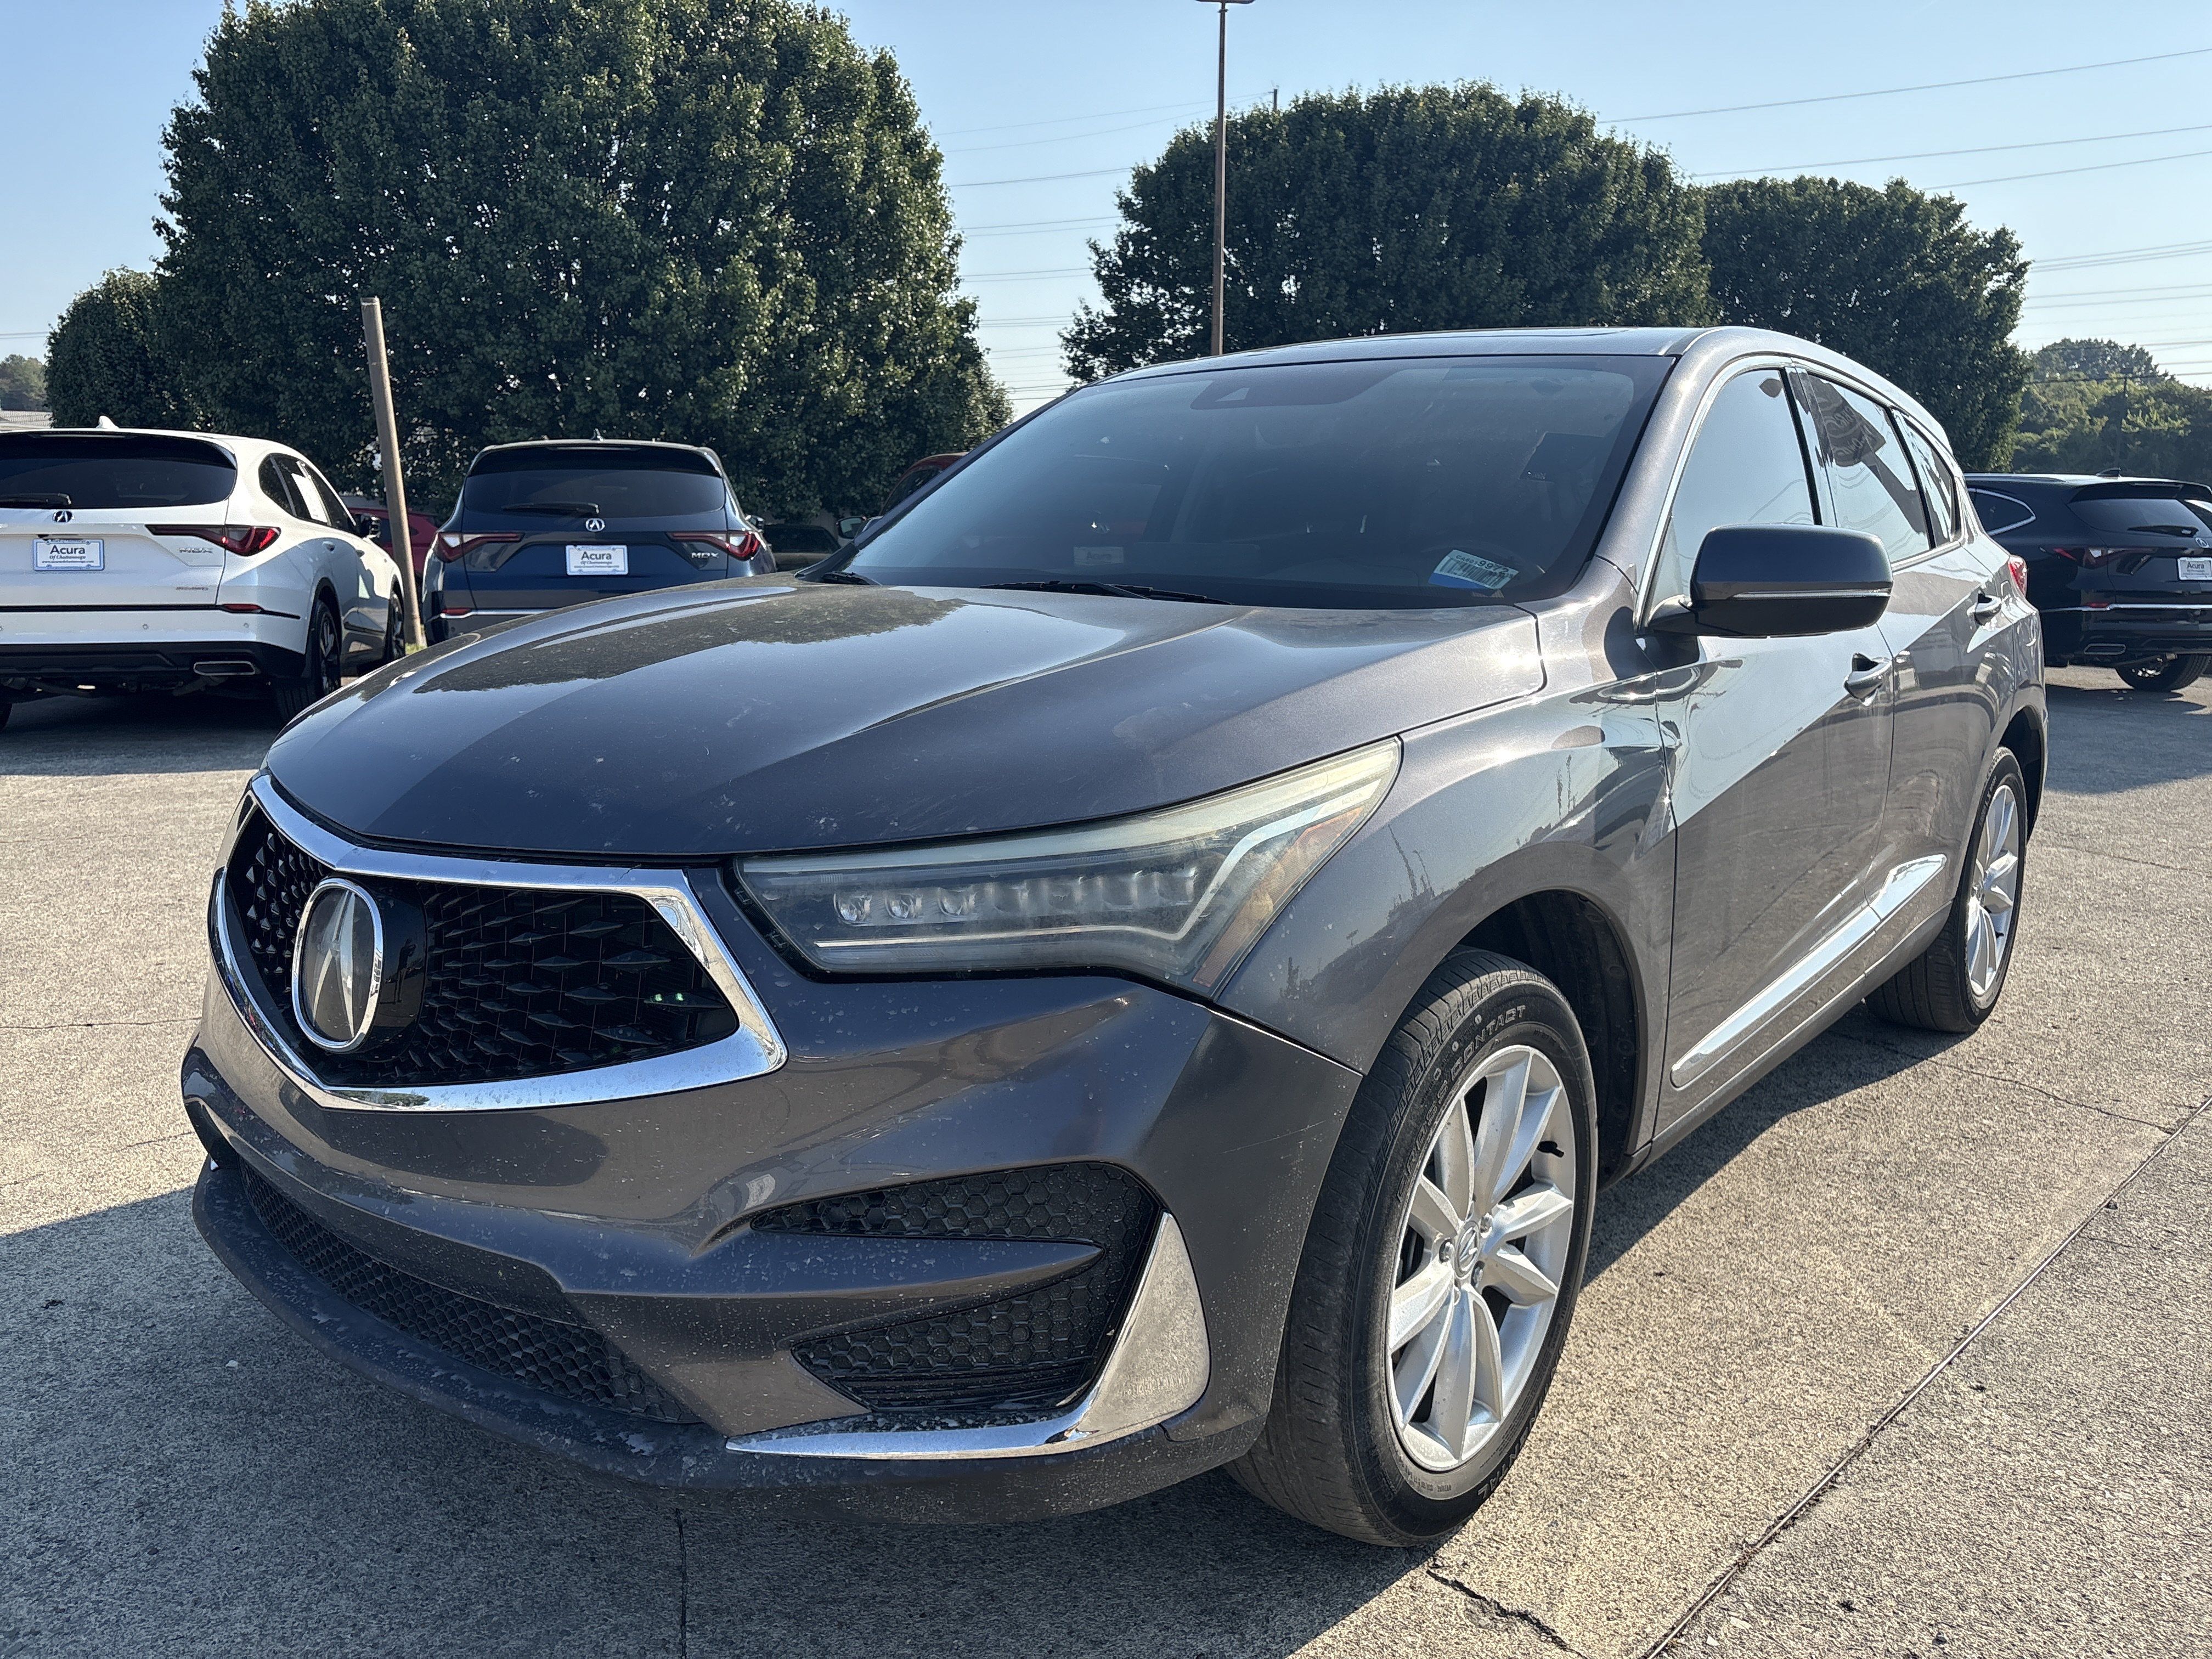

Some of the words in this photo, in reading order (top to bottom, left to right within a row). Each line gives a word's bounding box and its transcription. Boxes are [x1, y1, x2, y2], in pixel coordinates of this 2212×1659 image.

[50, 545, 85, 554] Acura
[581, 551, 612, 560] Acura
[1397, 1079, 1448, 1203] CROSS
[1451, 1005, 1526, 1081] CONTACT
